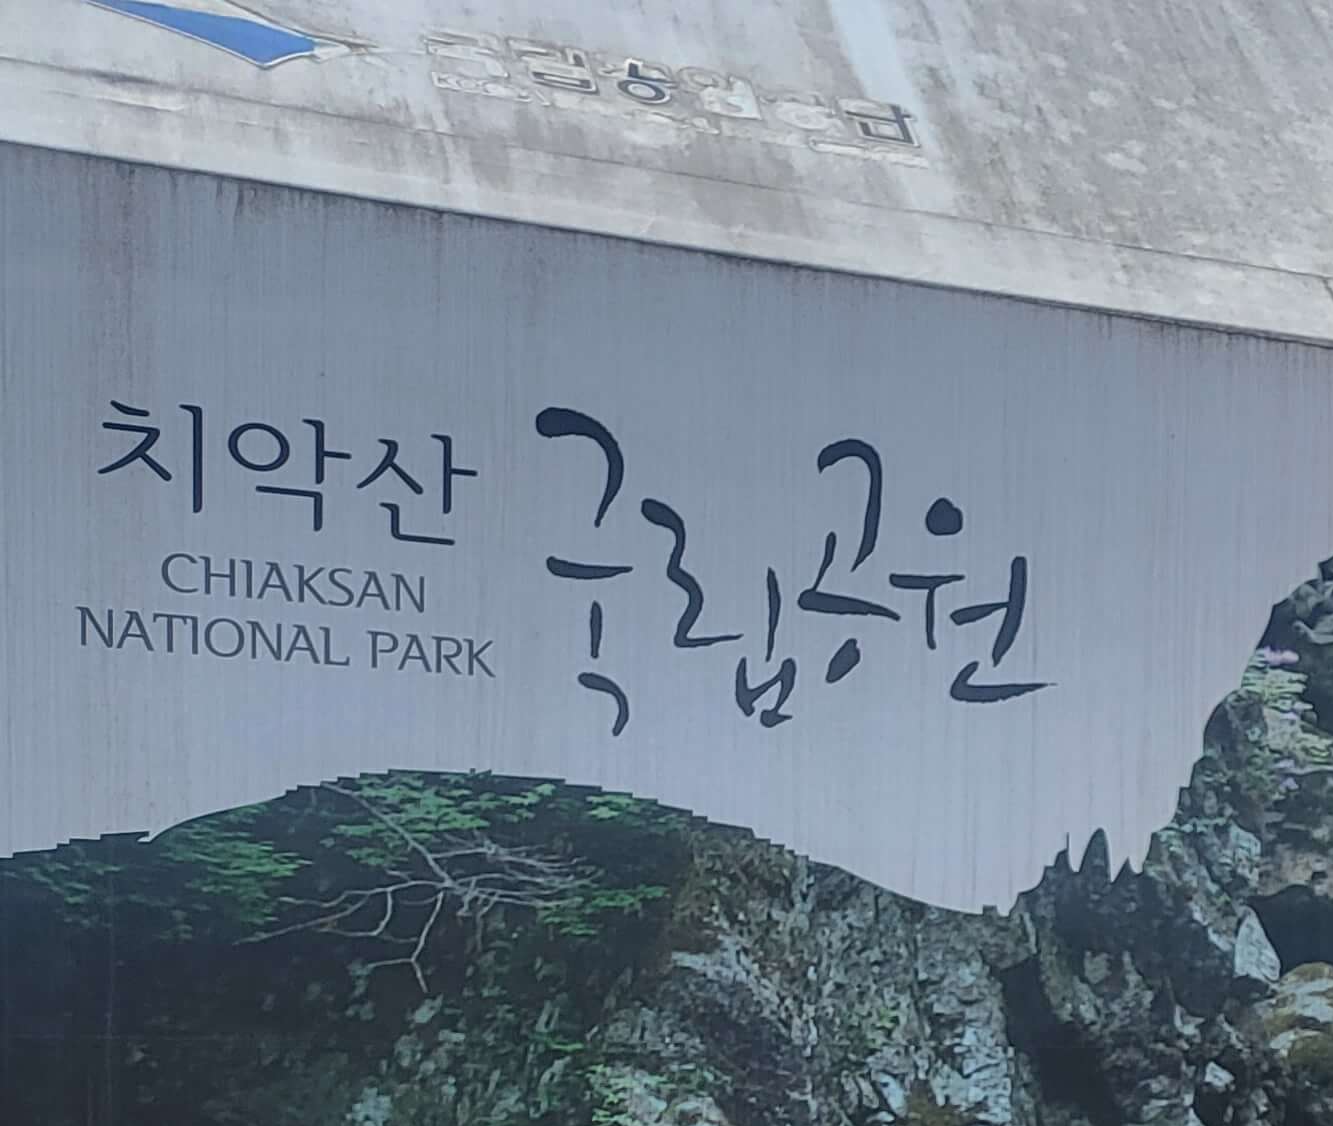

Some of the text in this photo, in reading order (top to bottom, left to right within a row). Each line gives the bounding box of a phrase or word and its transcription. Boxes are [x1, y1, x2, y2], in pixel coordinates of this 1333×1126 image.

[96, 401, 1056, 736] 치악산 국립공원
[161, 553, 426, 613] CHIAKSAN
[77, 605, 496, 679] NATIONAL PARK
